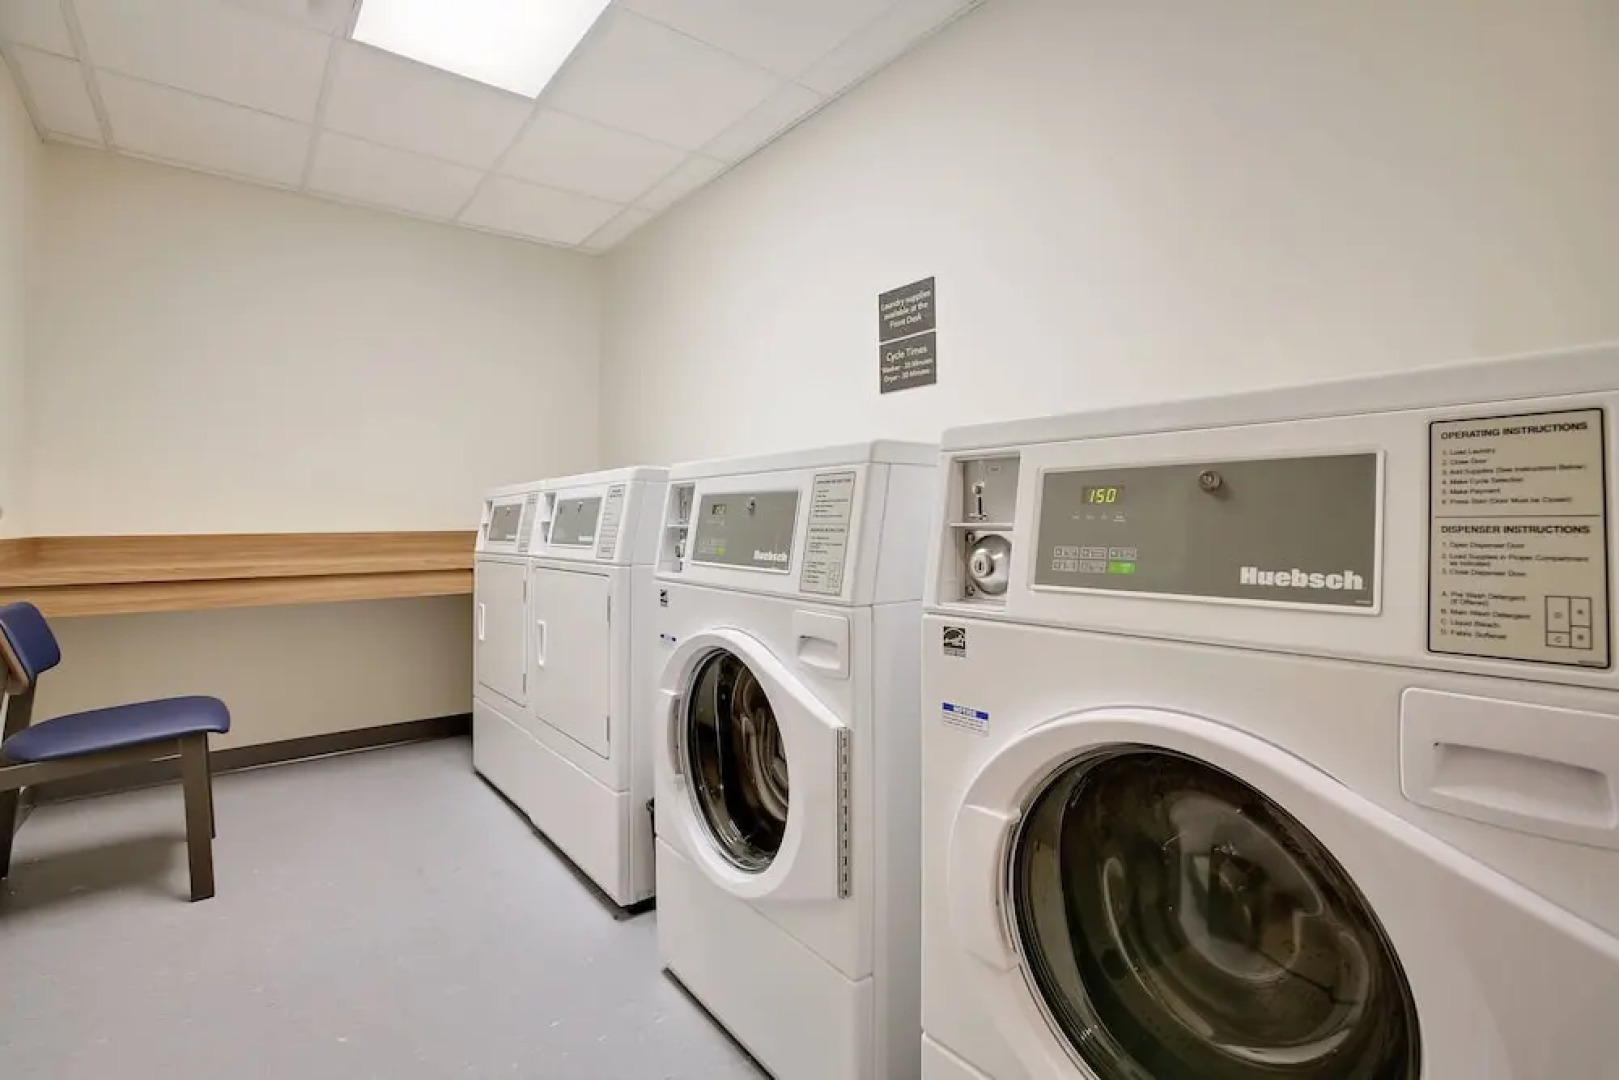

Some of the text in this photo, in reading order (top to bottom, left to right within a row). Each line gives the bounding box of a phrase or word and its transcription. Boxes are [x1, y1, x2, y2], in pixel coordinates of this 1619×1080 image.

[881, 290, 931, 311] Laundry supplies
[911, 304, 917, 312] at
[918, 302, 928, 310] the
[890, 312, 921, 329] Front Desk
[886, 346, 927, 363] Cycle Times
[1441, 422, 1587, 440] OPERATING INSTRUCTIONS
[1468, 447, 1495, 455] Laundry
[1089, 488, 1117, 503] 150
[1441, 525, 1590, 534] DISPENSER INSTRUCTIONS
[1240, 566, 1364, 590] Huebsch
